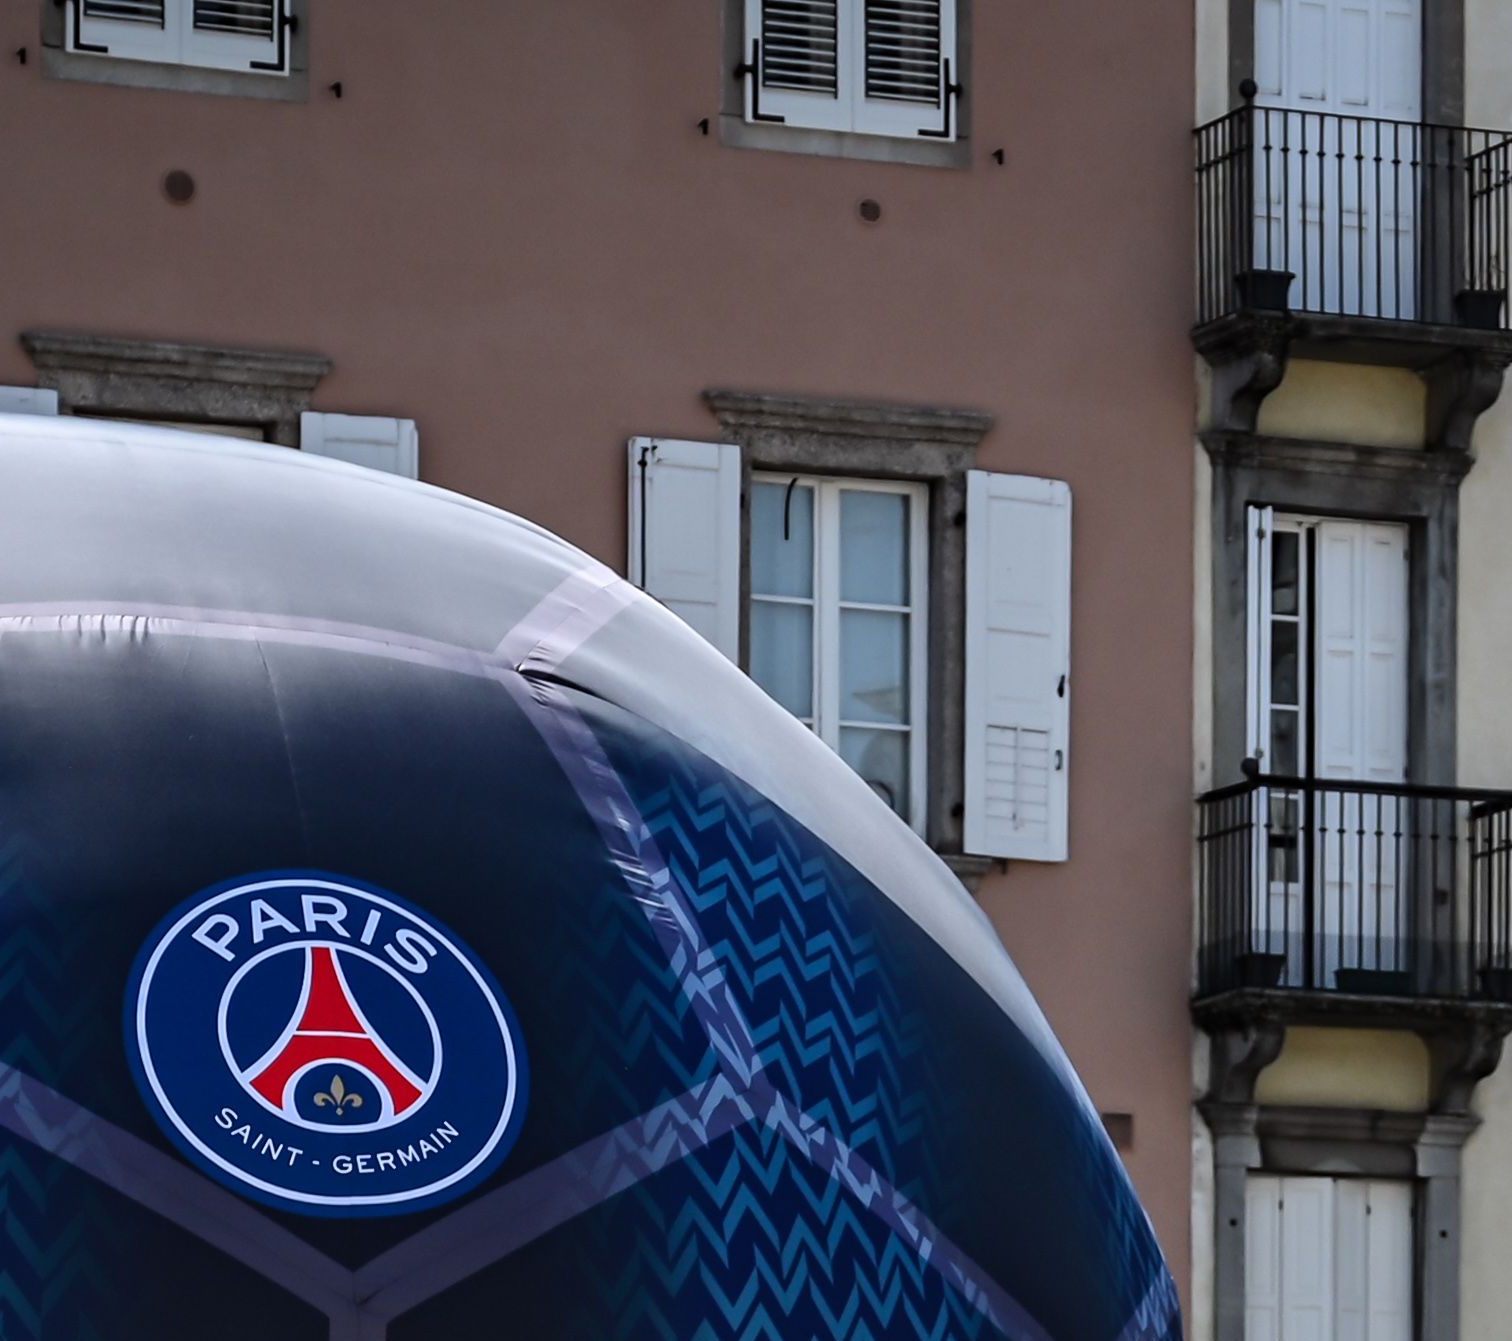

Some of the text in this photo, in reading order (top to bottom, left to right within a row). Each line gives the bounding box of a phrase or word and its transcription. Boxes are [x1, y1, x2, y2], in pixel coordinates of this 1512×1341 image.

[191, 893, 438, 974] PARIS
[214, 1107, 303, 1166] SAINT
[332, 1120, 460, 1174] GERMAIN
